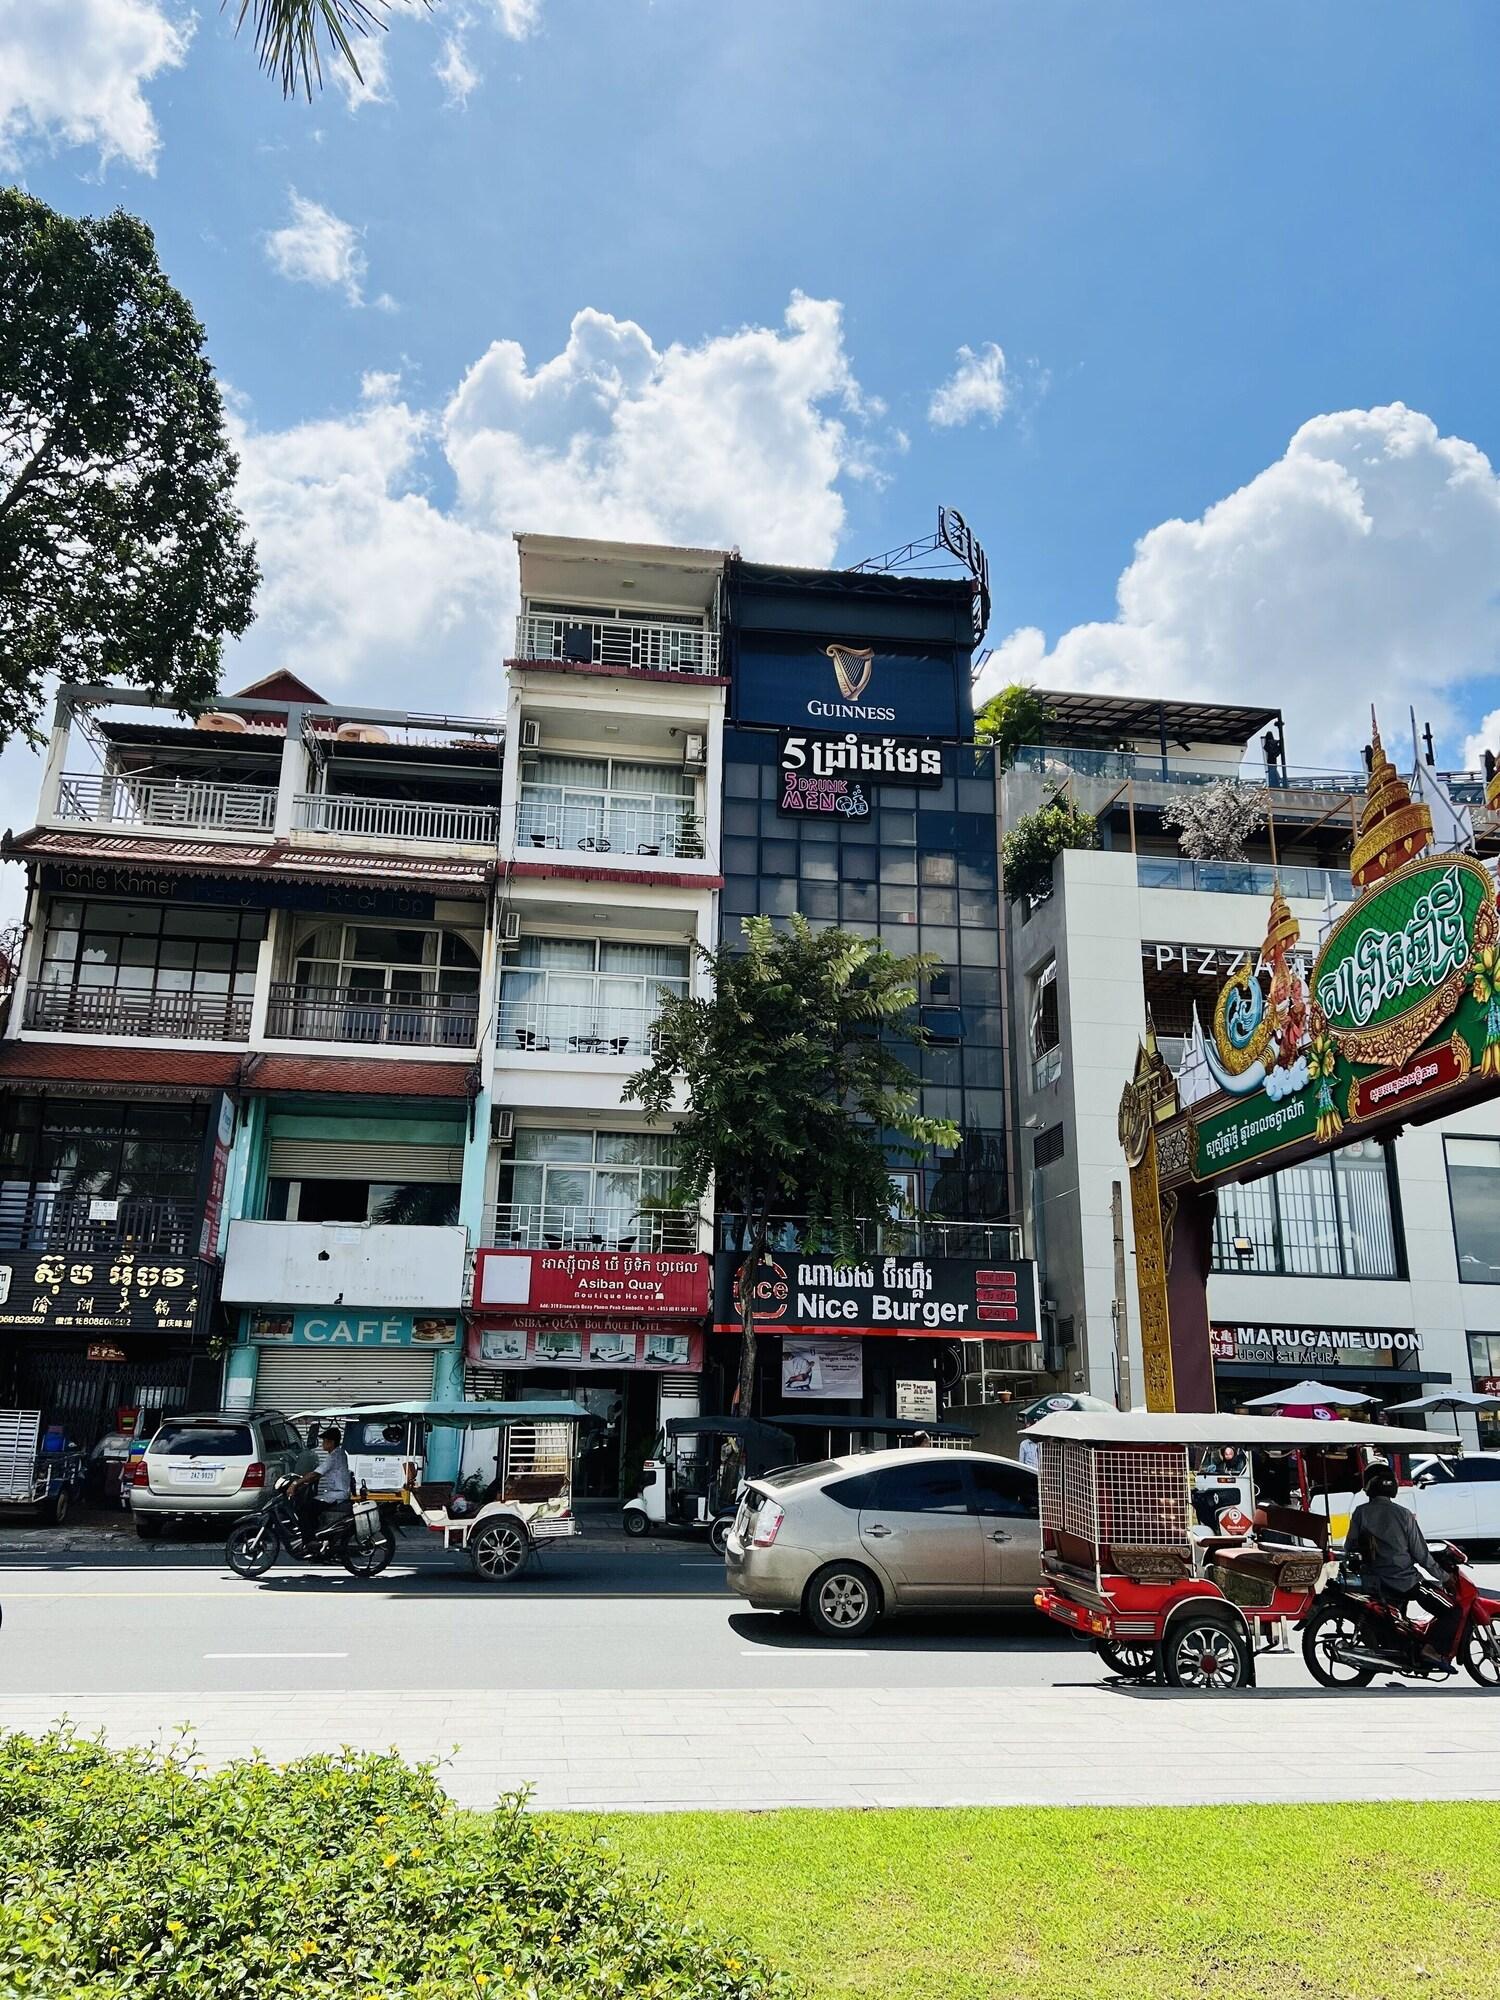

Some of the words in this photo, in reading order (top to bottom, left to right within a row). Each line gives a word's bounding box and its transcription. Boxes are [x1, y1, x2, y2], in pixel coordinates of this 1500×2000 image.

[807, 700, 896, 721] GUINNESS
[781, 737, 807, 769] 5
[784, 771, 797, 791] 5
[798, 778, 848, 794] DRUNK
[781, 790, 836, 811] MEN
[58, 868, 108, 890] Tonle
[114, 873, 178, 895] Khmer
[574, 1291, 622, 1300] Boutique
[625, 1292, 655, 1301] Hotel
[578, 1278, 624, 1290] Asiban
[628, 1279, 662, 1293] Quay
[796, 1292, 858, 1320] Nice
[872, 1295, 969, 1328] Burger
[303, 1315, 402, 1344] CAFÉ
[1237, 1327, 1362, 1350] MARUGAME
[1366, 1331, 1425, 1351] UDON
[1287, 1351, 1342, 1364] TEMPURA
